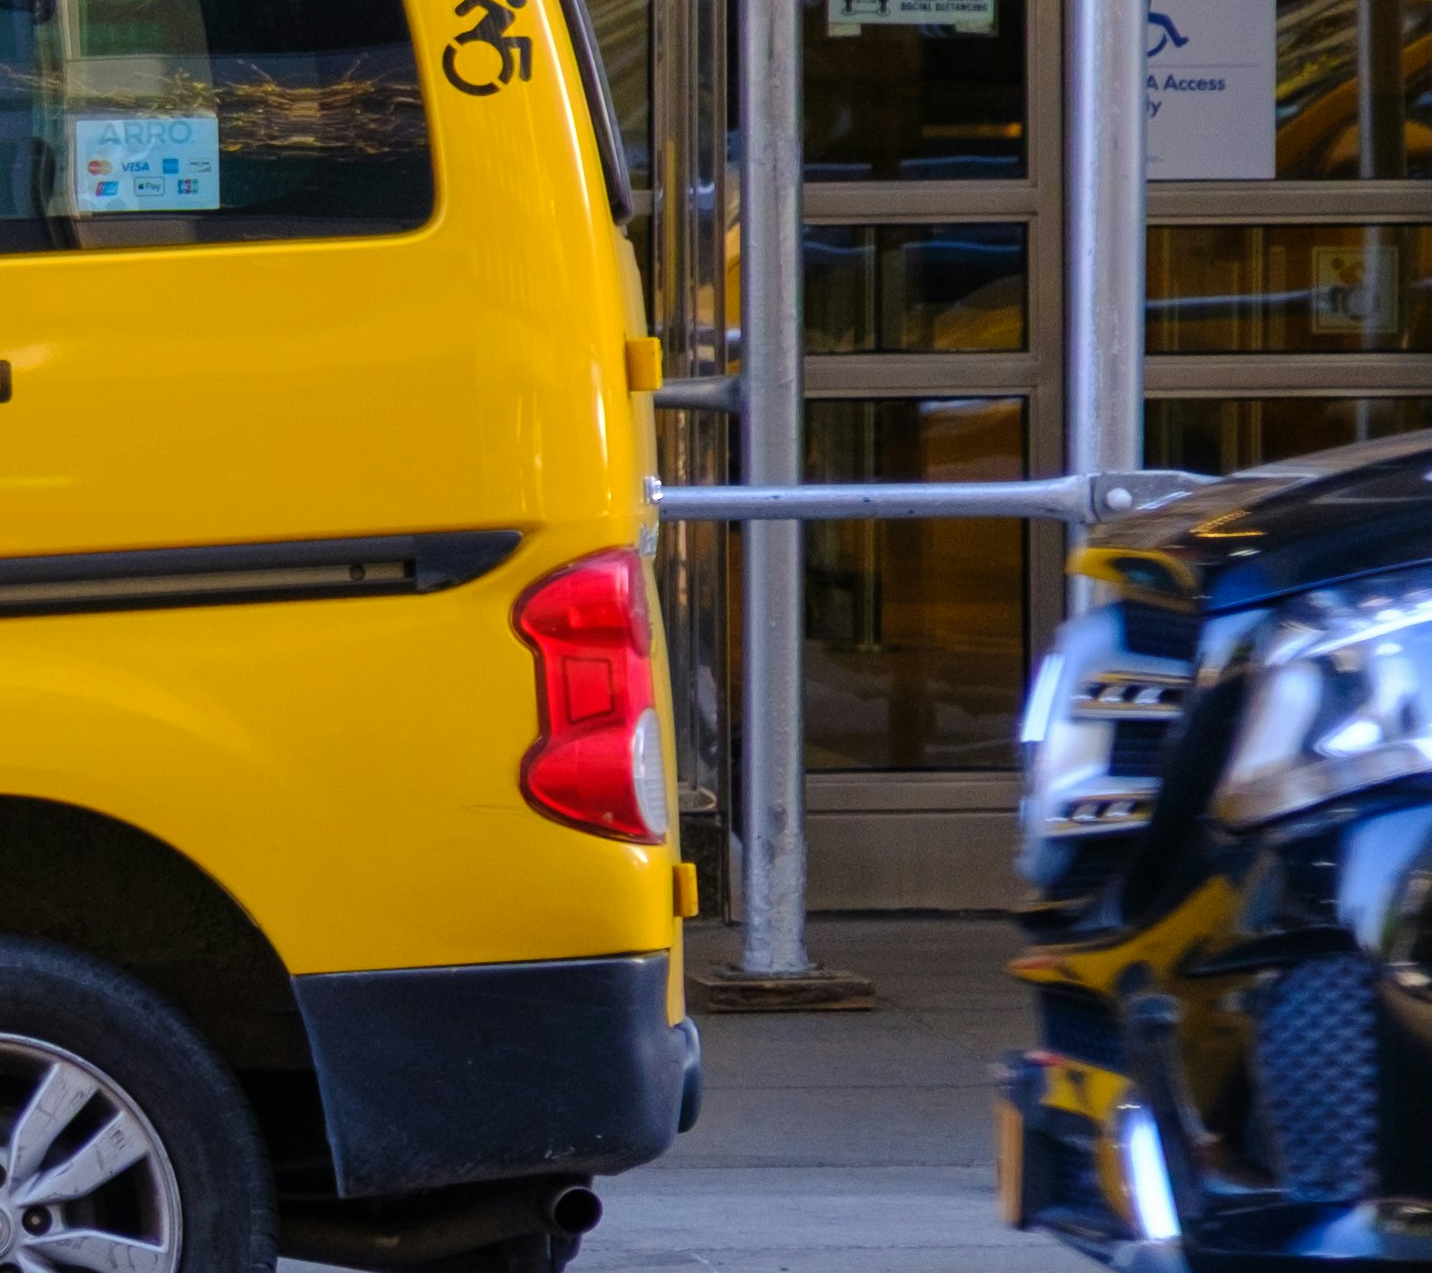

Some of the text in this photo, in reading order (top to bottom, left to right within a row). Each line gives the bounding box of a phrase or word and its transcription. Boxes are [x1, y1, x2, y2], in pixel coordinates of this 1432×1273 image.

[1164, 75, 1226, 91] Access
[99, 120, 193, 145] ARRO
[121, 161, 150, 173] VISA
